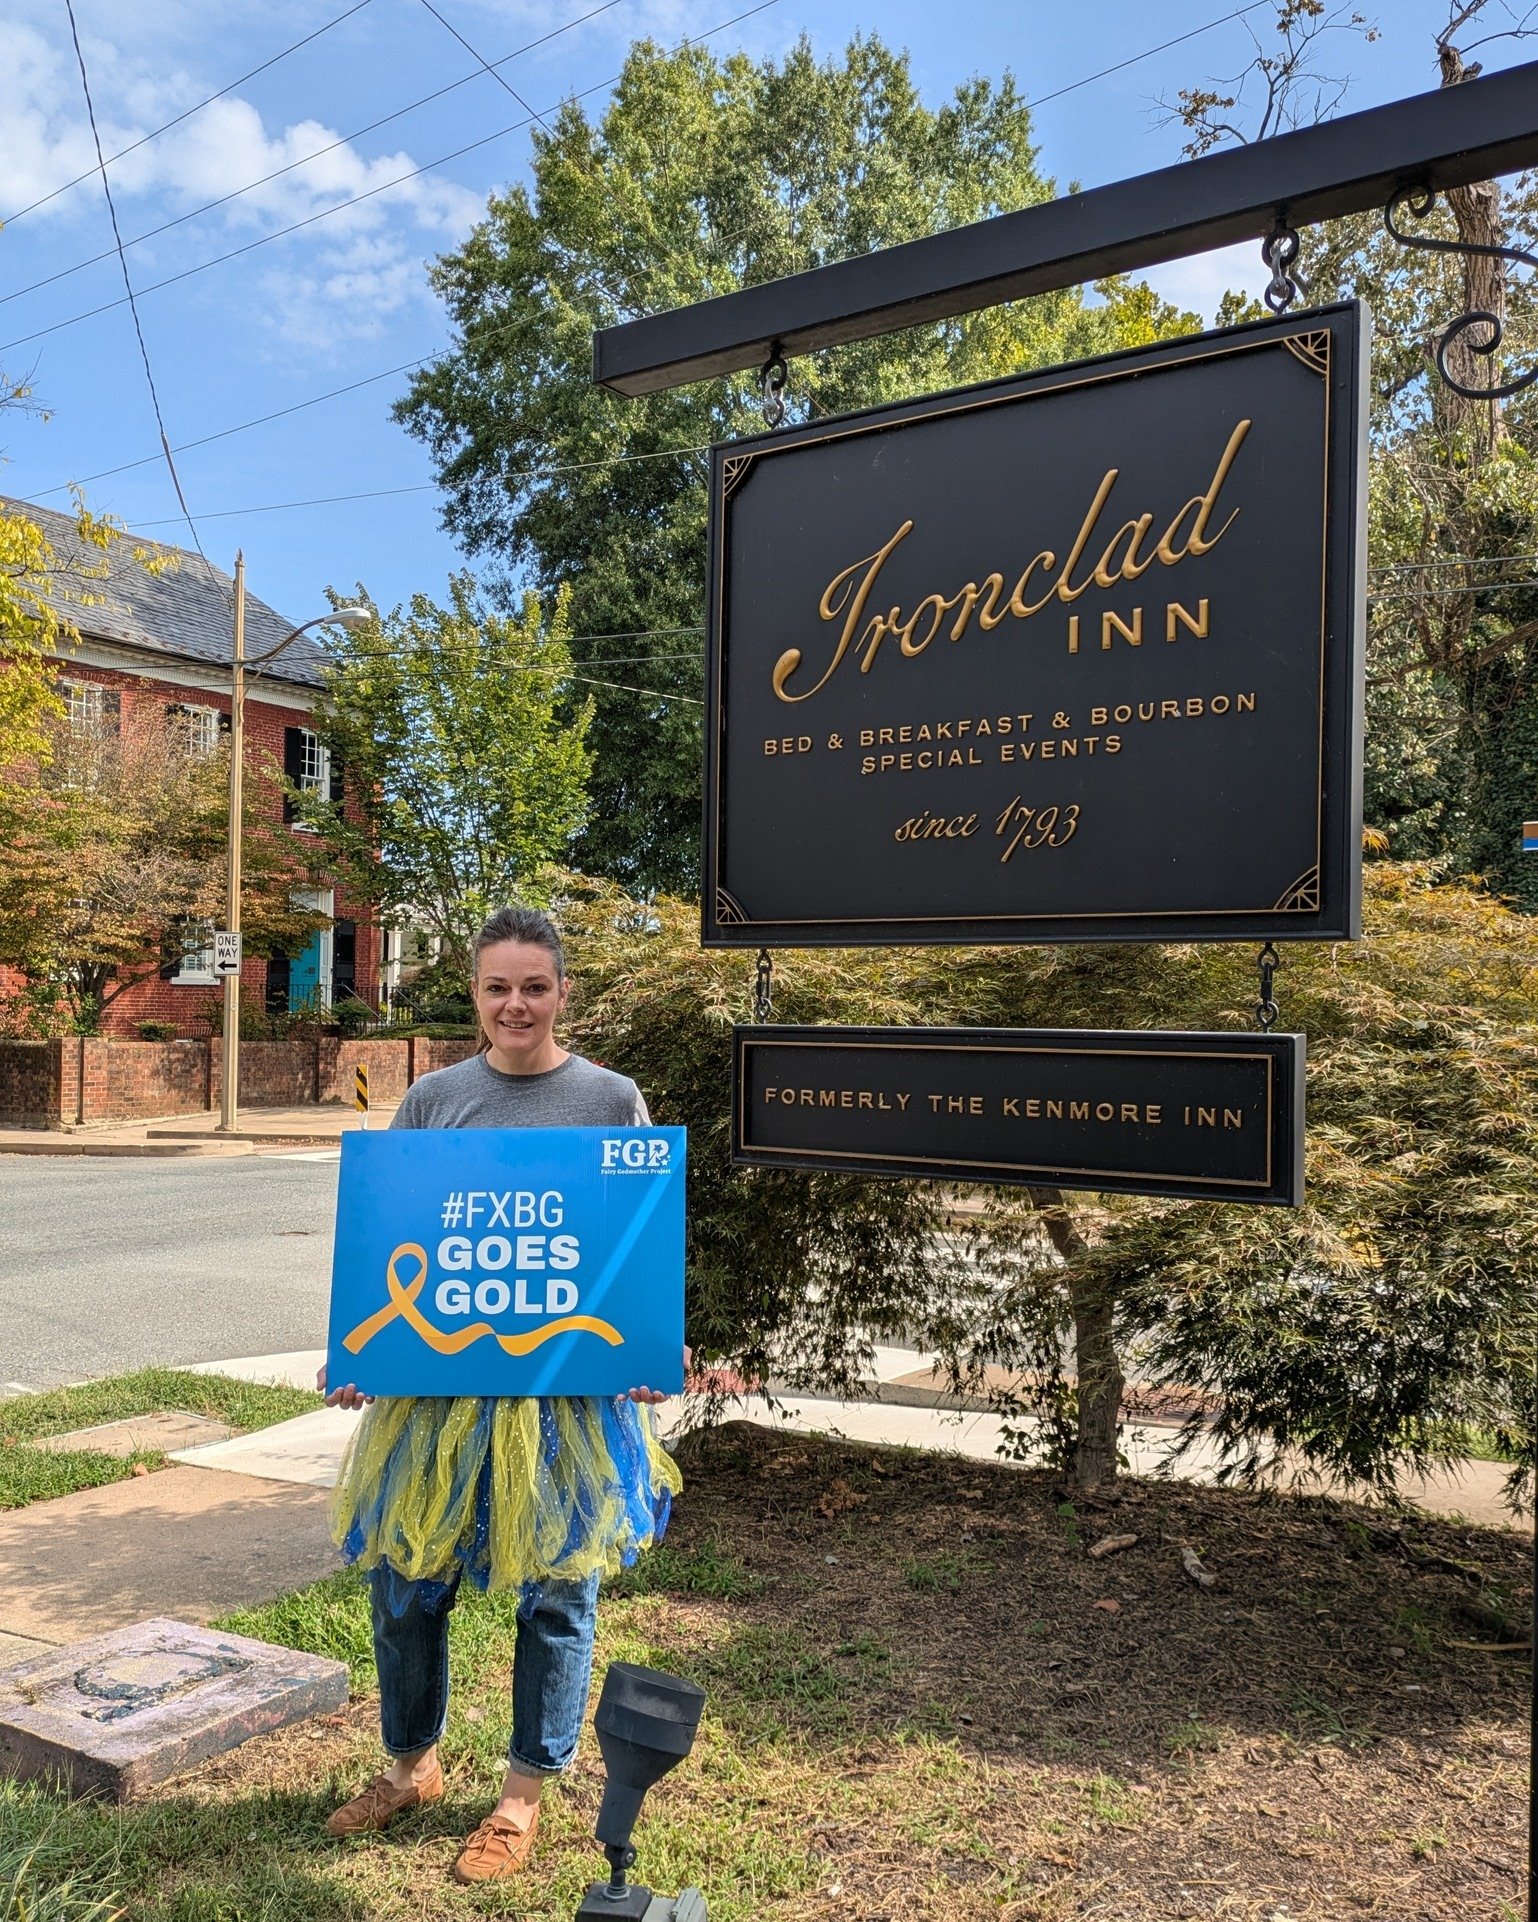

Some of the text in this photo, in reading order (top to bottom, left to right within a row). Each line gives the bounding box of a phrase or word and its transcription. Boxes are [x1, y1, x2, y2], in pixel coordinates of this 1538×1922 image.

[771, 418, 1252, 703] Ironclad
[1068, 598, 1210, 655] INN
[763, 692, 1256, 756] BED & BREAKFAST & BOURBON
[861, 734, 1123, 775] SPECIAL EVENTS
[894, 795, 1080, 863] since 1793
[218, 936, 237, 946] ONE
[218, 948, 238, 958] WAY
[764, 1087, 1243, 1129] FORMERLY THE KENMORE INN
[601, 1139, 670, 1167] FGP
[440, 1190, 564, 1229] #FXBG
[437, 1234, 580, 1271] GOES
[434, 1279, 579, 1315] GOLD
